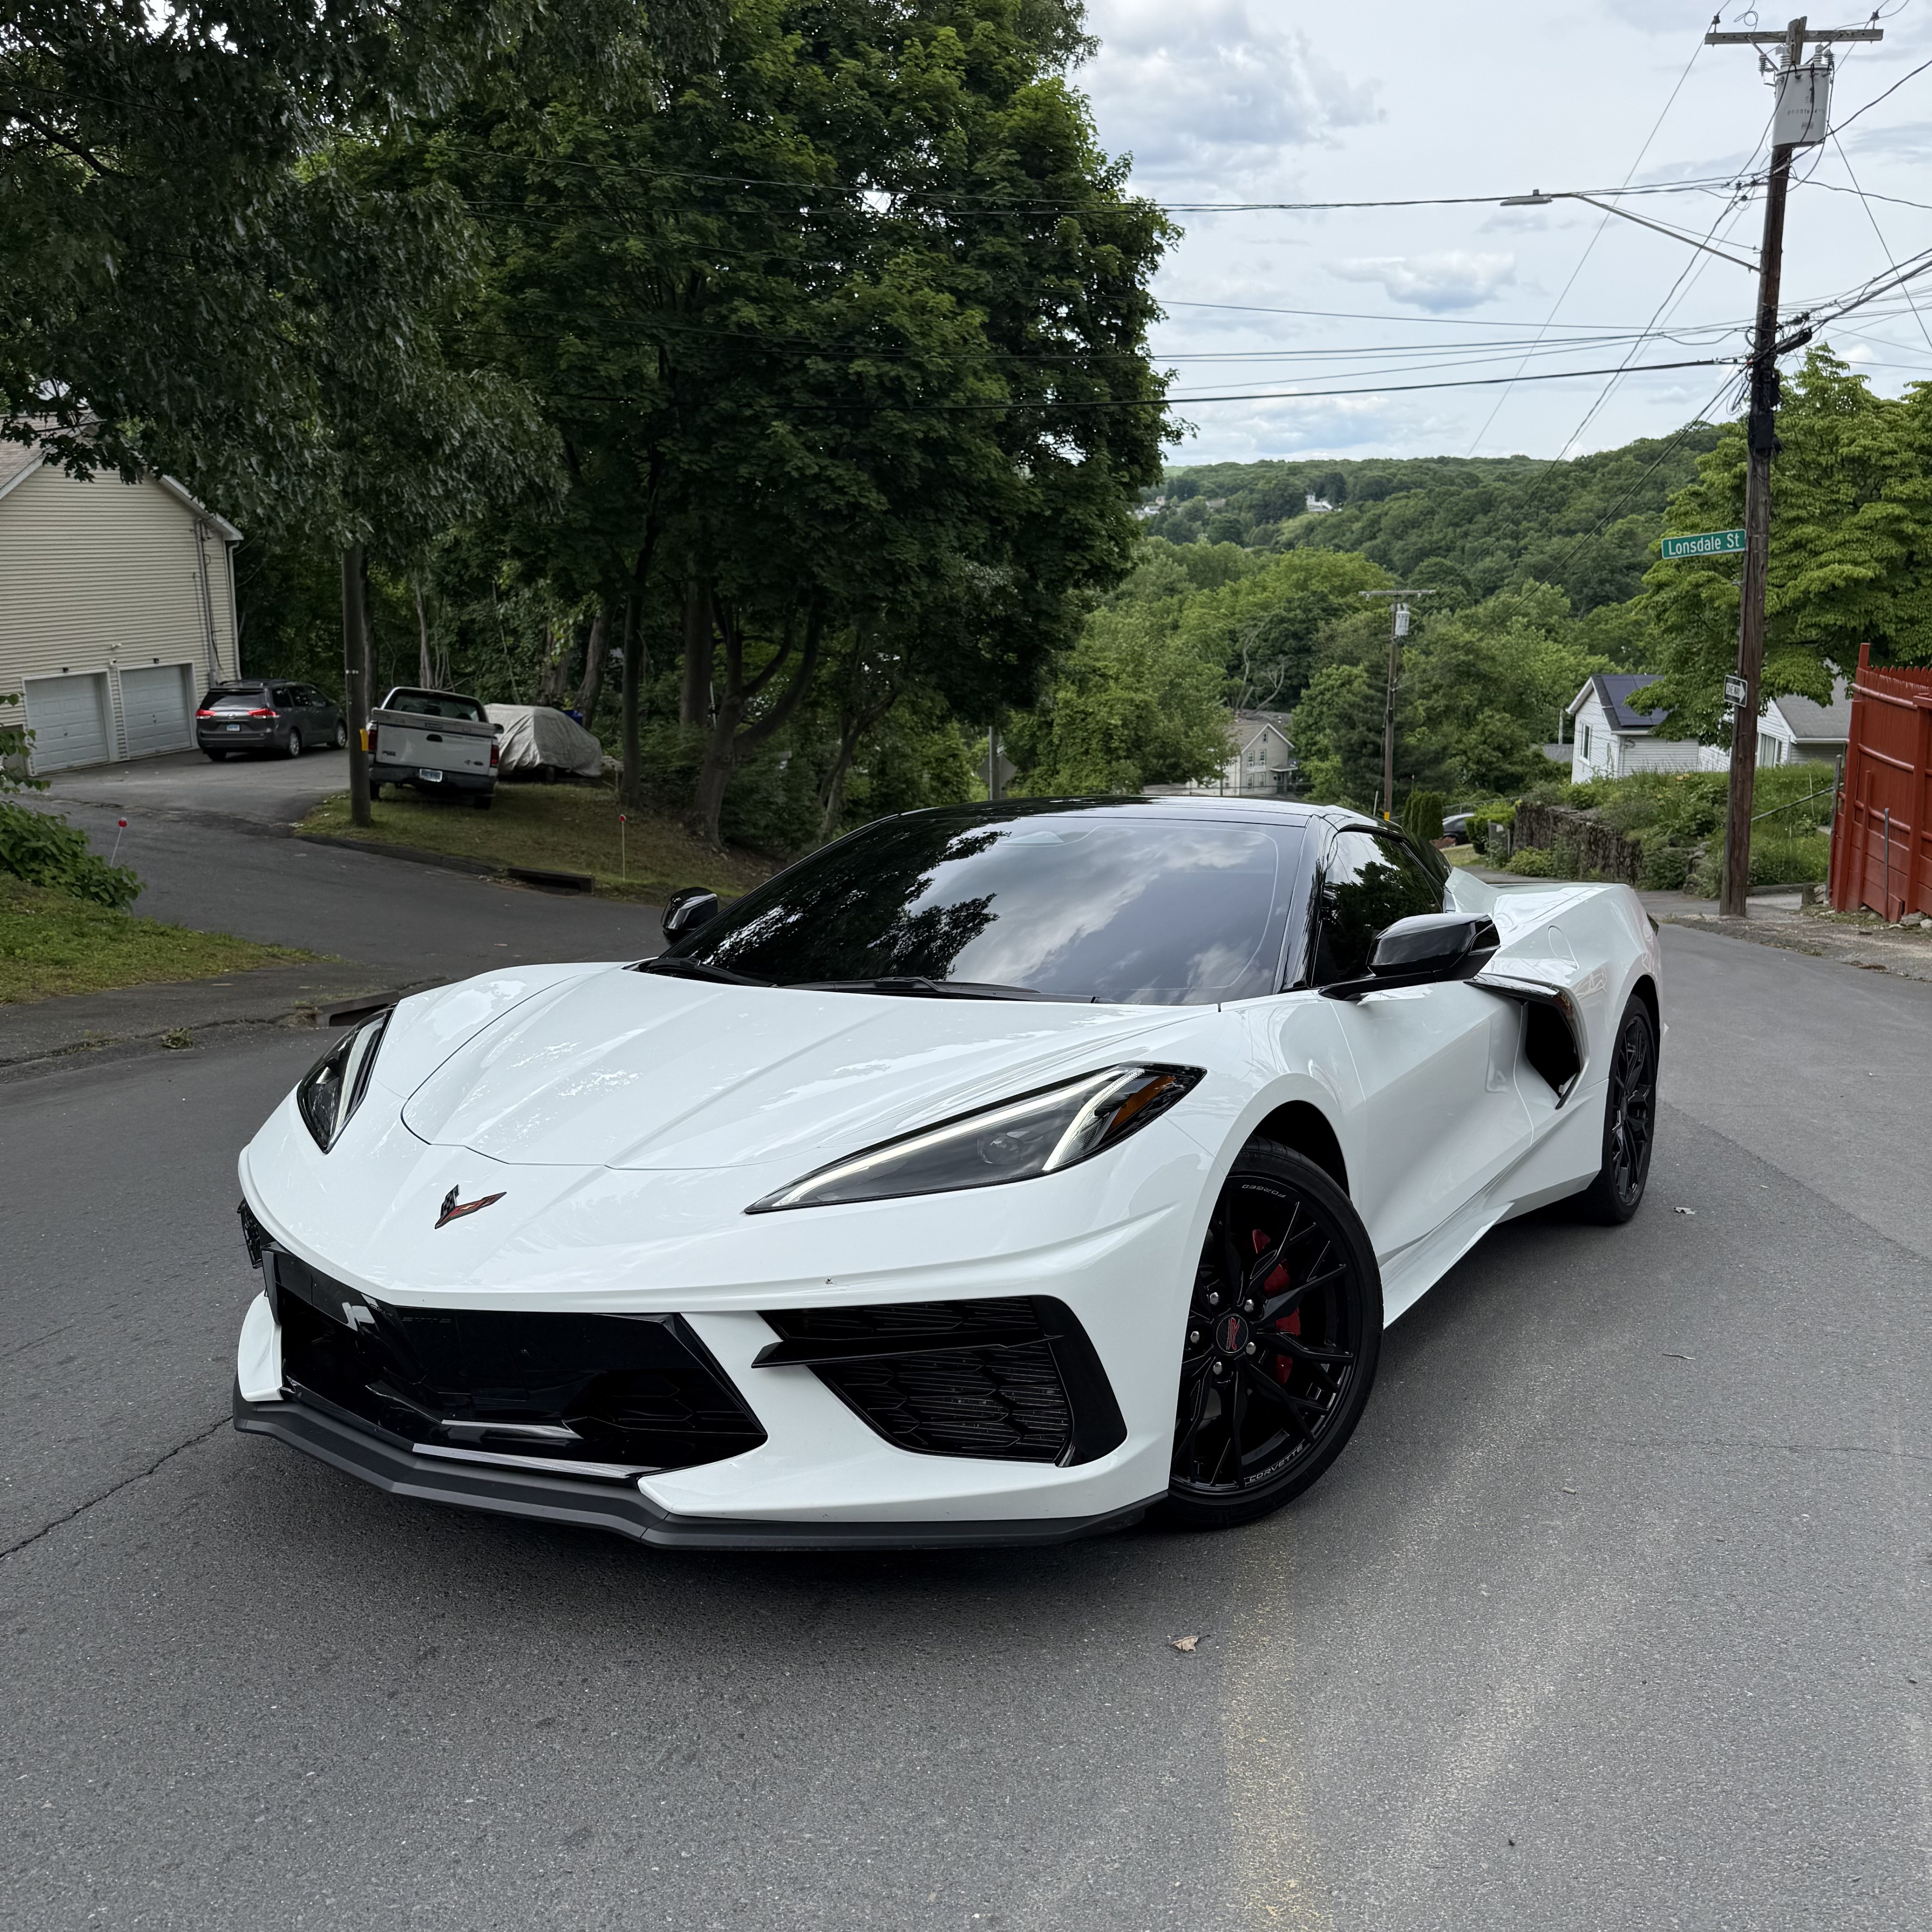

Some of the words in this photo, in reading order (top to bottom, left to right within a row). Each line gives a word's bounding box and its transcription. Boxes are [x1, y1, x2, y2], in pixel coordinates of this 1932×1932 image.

[1668, 536, 1721, 555] Lonsdale
[1727, 533, 1740, 548] St
[1241, 1184, 1286, 1198] FORGED
[1249, 1443, 1303, 1482] CORVETTE
